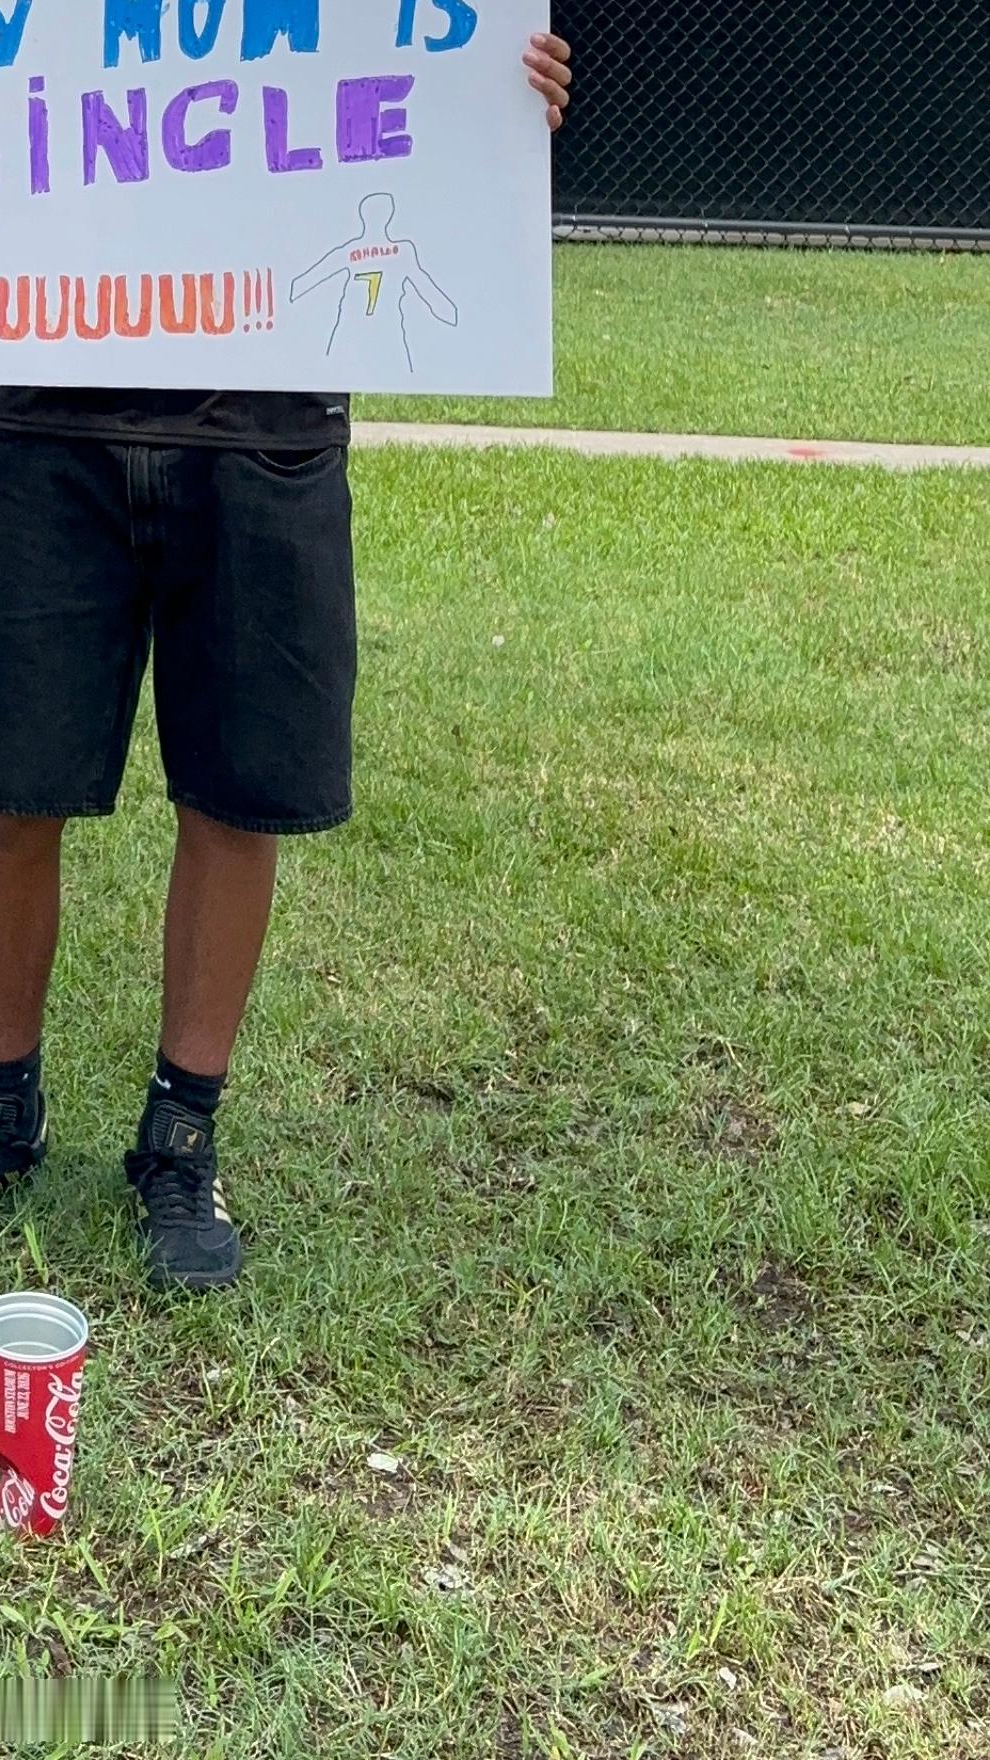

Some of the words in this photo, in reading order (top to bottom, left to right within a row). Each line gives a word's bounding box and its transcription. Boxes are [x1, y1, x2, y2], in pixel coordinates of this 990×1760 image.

[350, 244, 400, 262] RONALDO
[354, 271, 383, 316] 7
[40, 1371, 83, 1519] Coca-Cola
